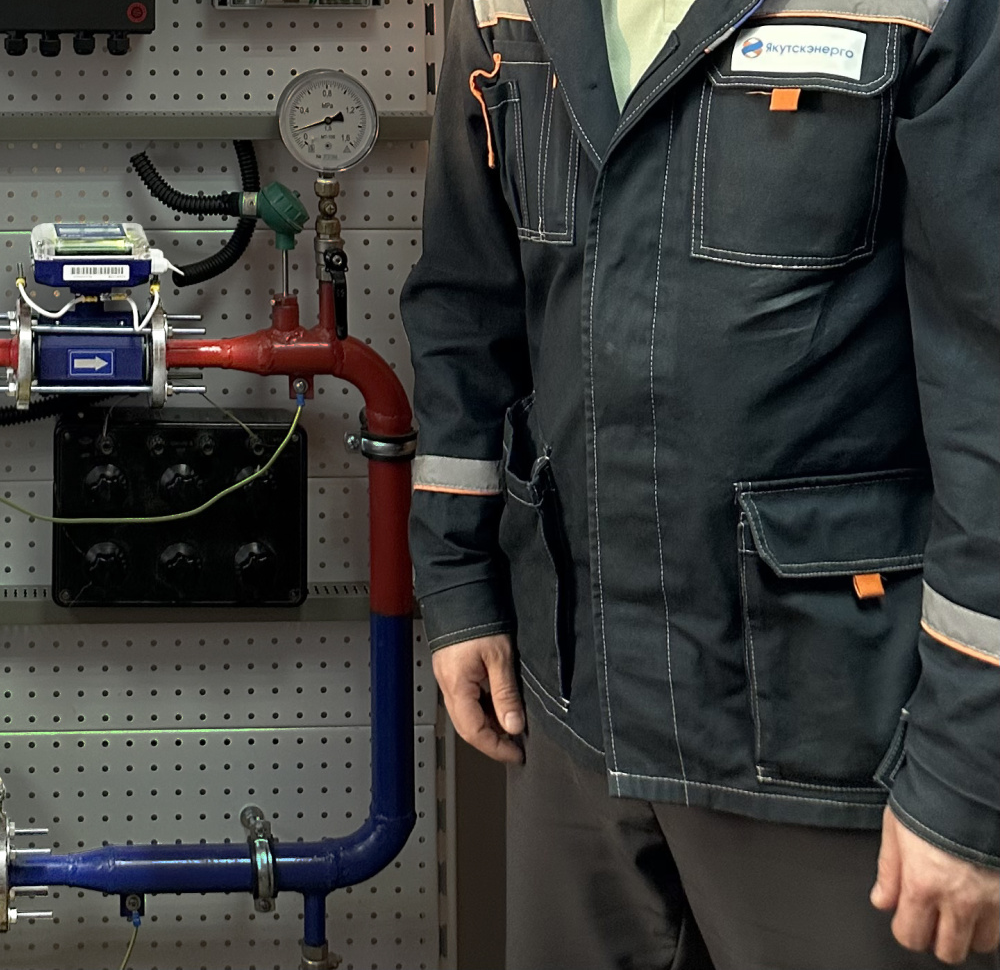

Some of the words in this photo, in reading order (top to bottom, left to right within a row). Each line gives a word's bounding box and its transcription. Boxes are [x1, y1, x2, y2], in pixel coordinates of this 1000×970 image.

[765, 42, 855, 59] Якутскэнерго
[322, 90, 332, 98] 0,8
[346, 106, 354, 114] 1,2
[341, 134, 350, 142] 1,6
